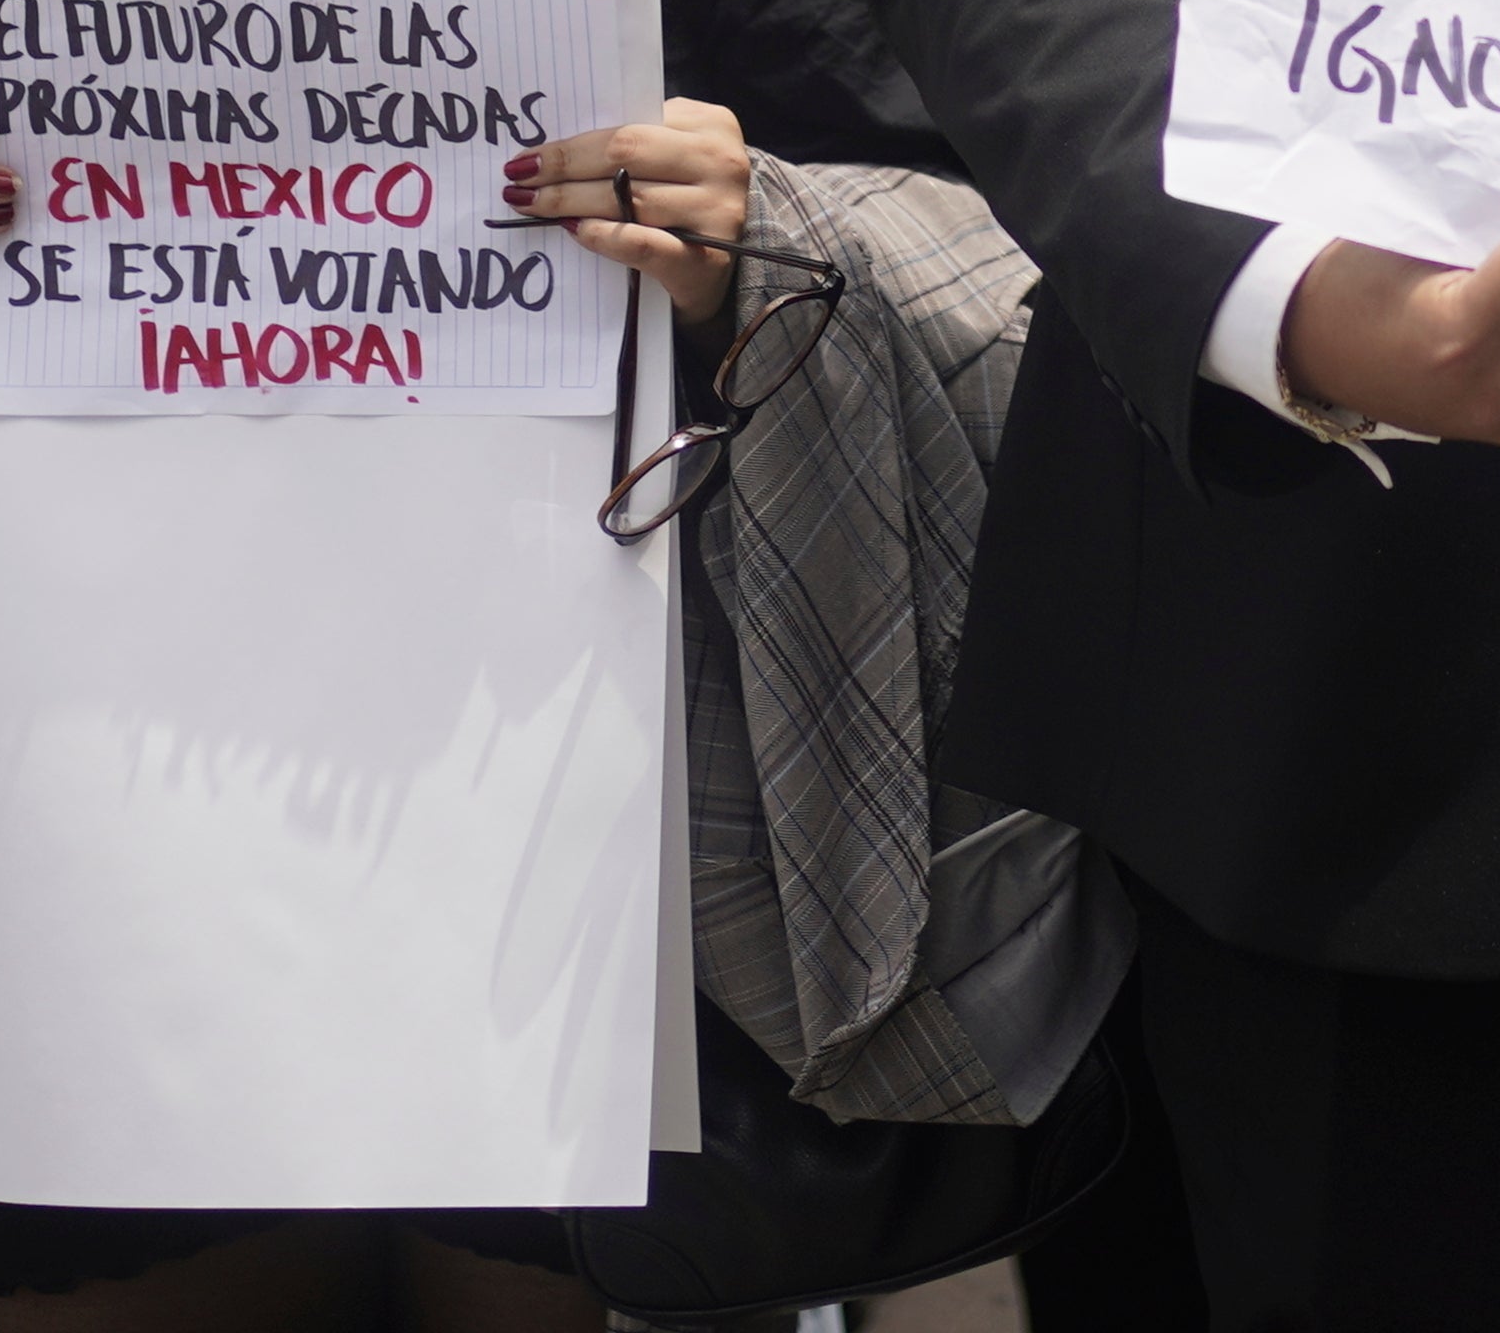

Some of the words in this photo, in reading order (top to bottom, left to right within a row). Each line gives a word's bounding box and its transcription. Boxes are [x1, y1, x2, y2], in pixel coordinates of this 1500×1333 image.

[290, 1, 358, 65] DE
[378, 3, 480, 69] LAS
[303, 81, 548, 148] DÉCADAS
[47, 155, 145, 223] EN
[2, 239, 81, 307] SE
[108, 225, 253, 307] ESTÁ
[268, 246, 556, 313] VOTANDO
[138, 308, 424, 405] ¡AHORA!
